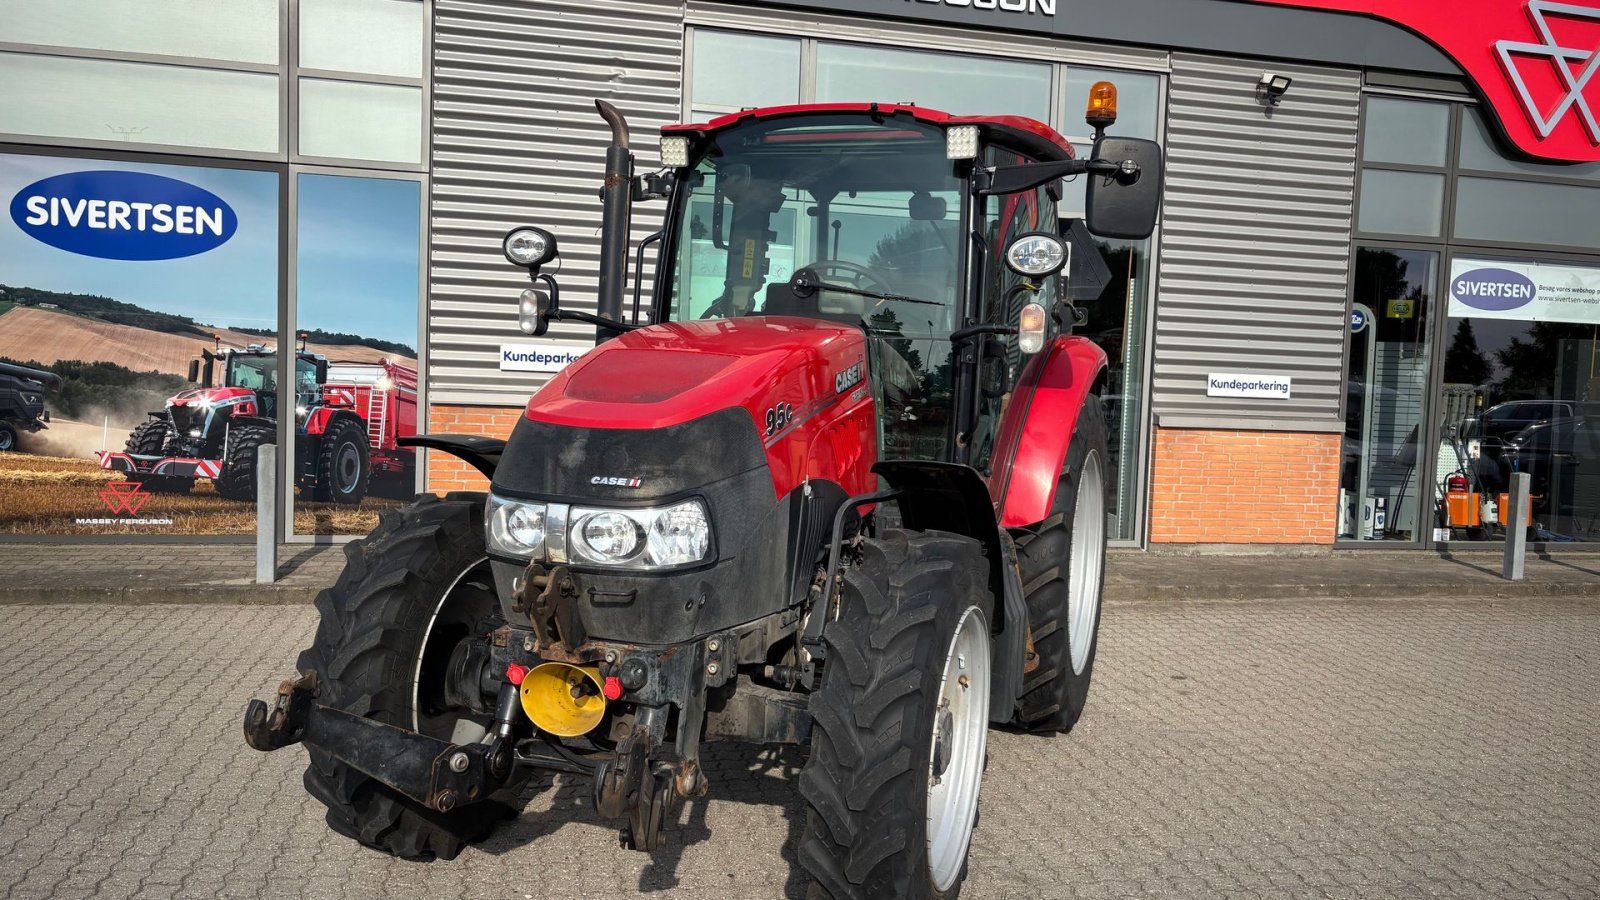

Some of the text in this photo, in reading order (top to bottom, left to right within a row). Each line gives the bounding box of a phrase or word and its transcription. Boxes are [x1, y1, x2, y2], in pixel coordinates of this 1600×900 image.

[25, 195, 223, 236] SIVERTSEN
[1456, 280, 1531, 298] SIVERTSEN
[1571, 287, 1596, 295] webshop
[835, 364, 858, 394] CASE
[1210, 379, 1288, 394] Kundeparkering
[591, 476, 627, 486] CASE
